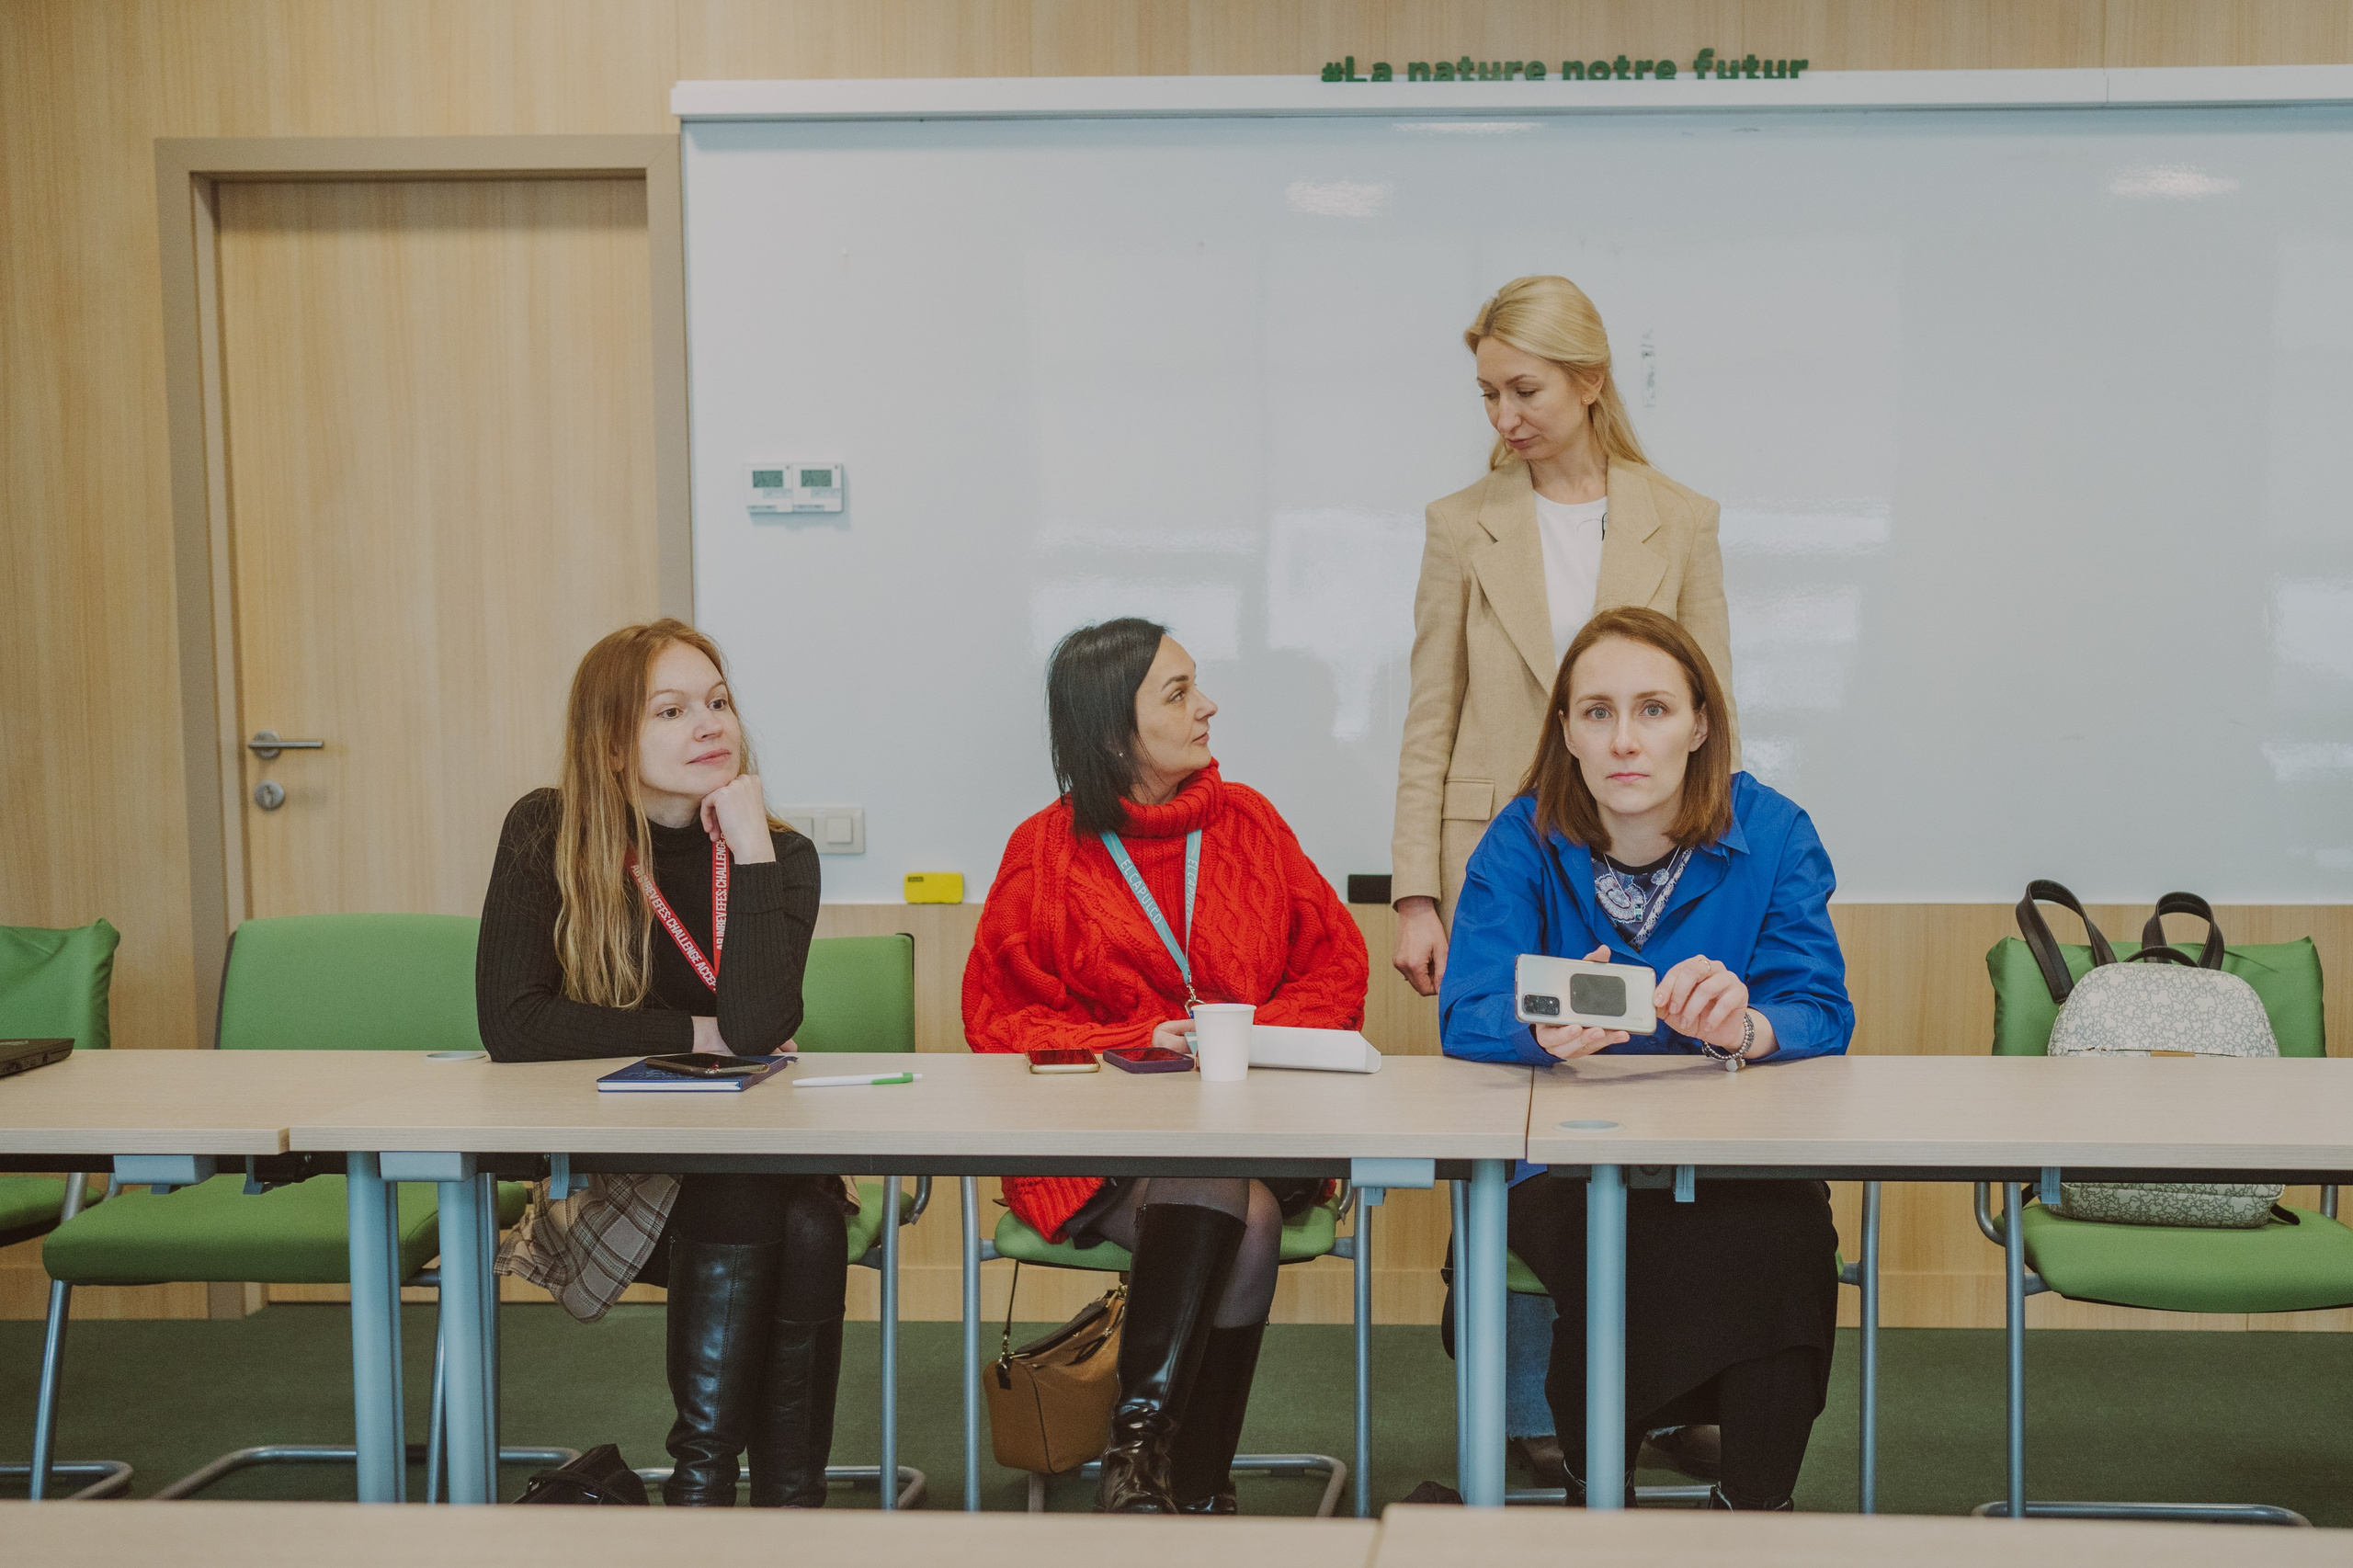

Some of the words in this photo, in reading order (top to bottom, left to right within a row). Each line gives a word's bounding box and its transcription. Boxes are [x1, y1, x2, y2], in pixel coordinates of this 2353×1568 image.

[1321, 55, 1392, 83] #La
[1407, 55, 1547, 82] nature
[1563, 54, 1677, 81] notre
[1693, 48, 1809, 80] futur
[715, 839, 727, 888] CHALLENGE
[1188, 858, 1199, 871] EL
[715, 888, 727, 911] EFES:
[1120, 858, 1131, 876] EL
[1129, 872, 1163, 925] CAPULCO
[652, 898, 672, 921] EFES:
[665, 917, 703, 964] CHALLENGE
